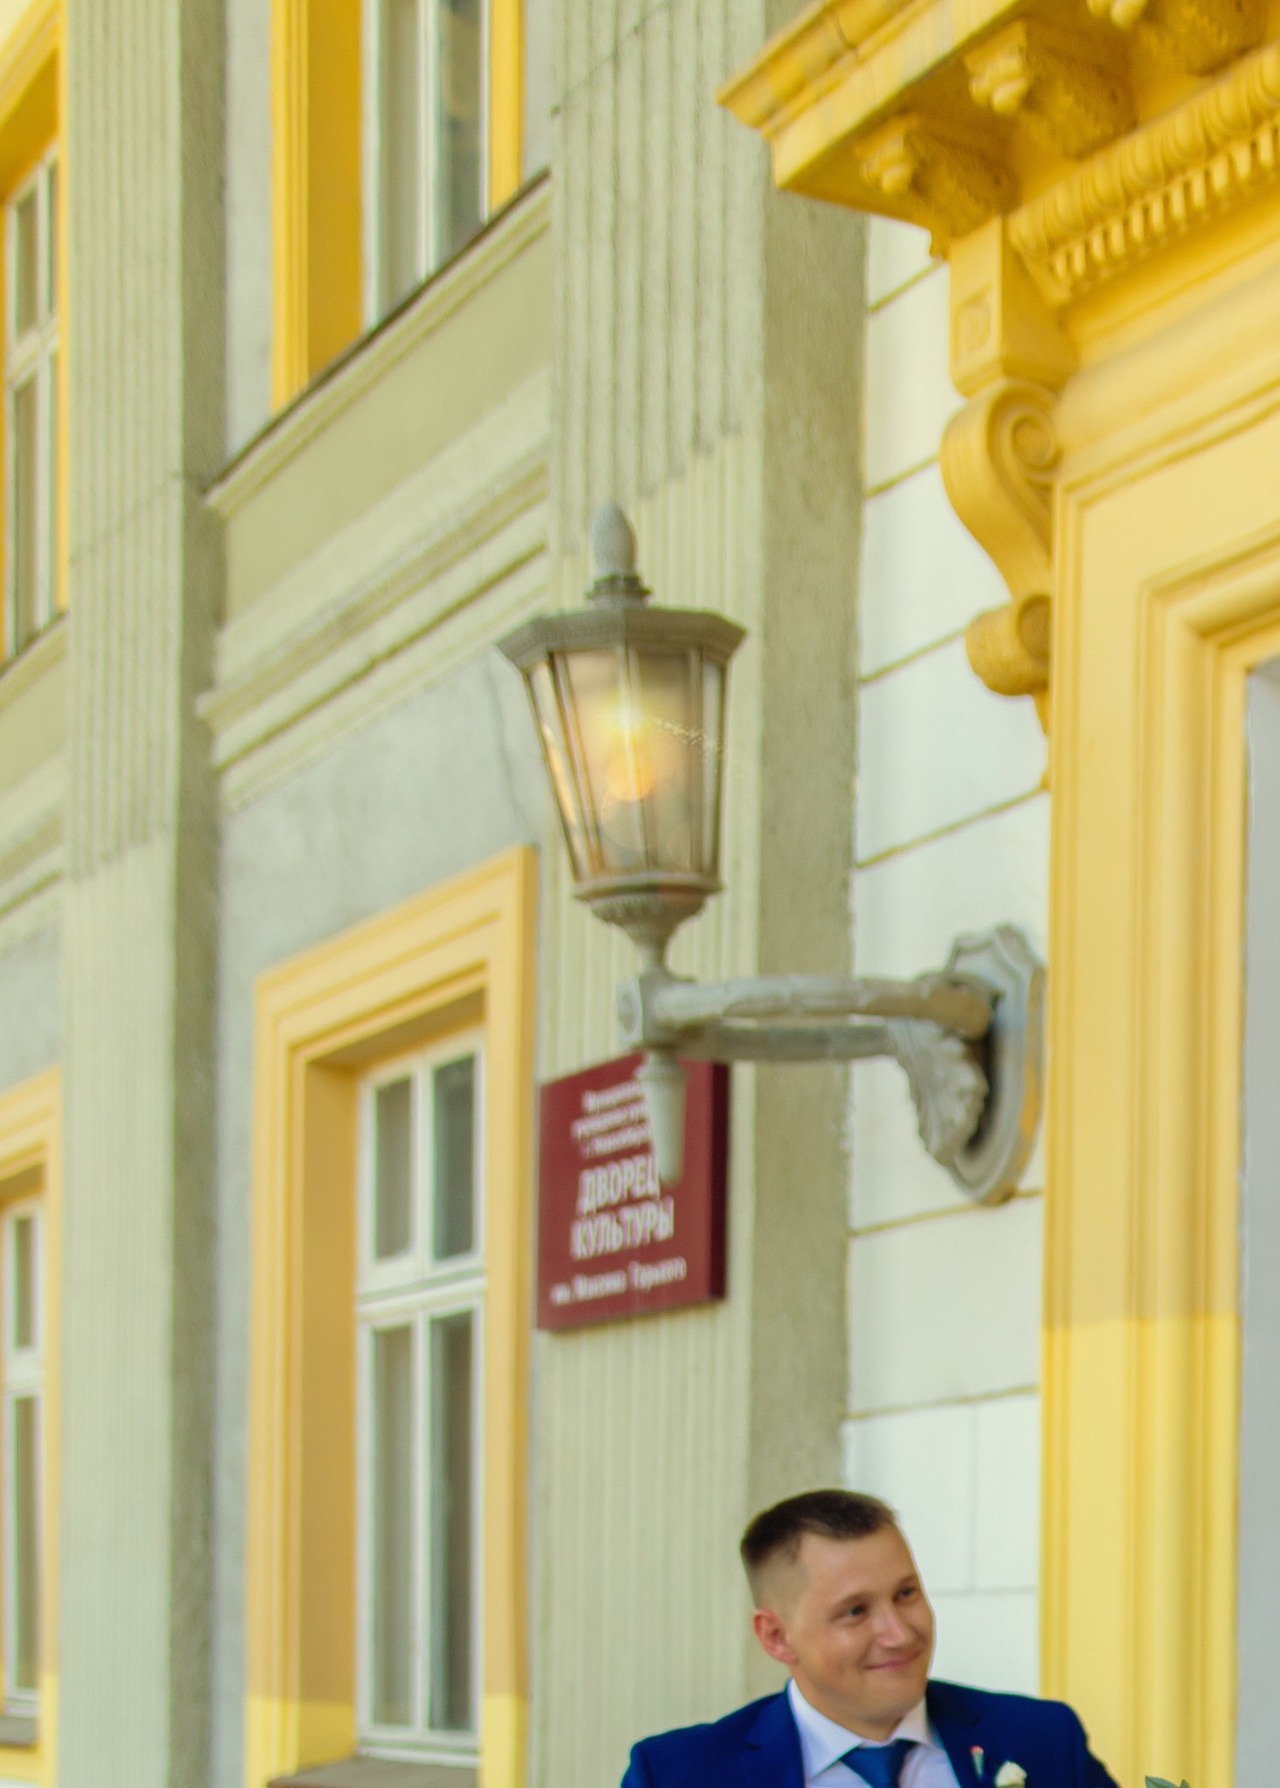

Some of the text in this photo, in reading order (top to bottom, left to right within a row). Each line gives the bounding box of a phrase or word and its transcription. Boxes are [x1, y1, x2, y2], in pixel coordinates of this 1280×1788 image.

[578, 1154, 661, 1216] ДВОРЕЦ
[571, 1196, 674, 1259] КУЛЬТУРЫ
[629, 1257, 687, 1291] Горького
